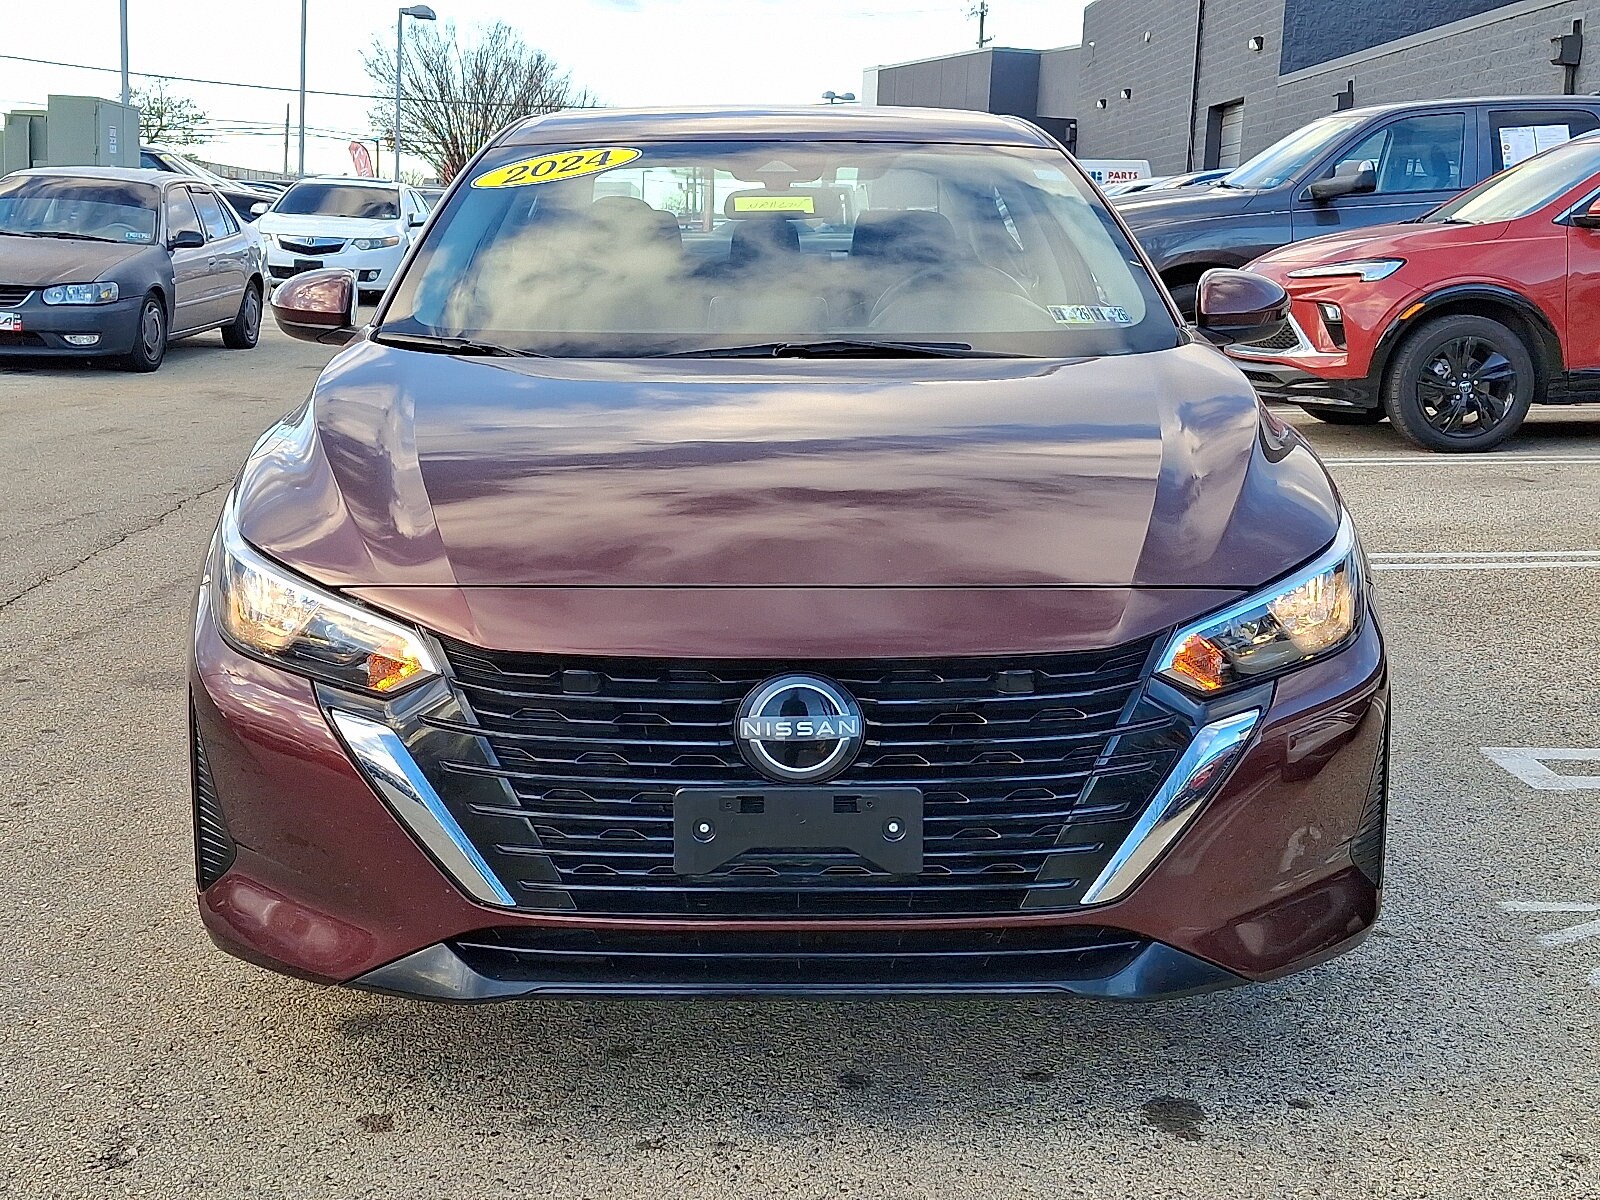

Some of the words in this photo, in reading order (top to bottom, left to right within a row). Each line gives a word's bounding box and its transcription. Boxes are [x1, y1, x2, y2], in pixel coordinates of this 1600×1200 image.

[501, 150, 613, 185] 2024
[1108, 171, 1138, 179] PARTS
[742, 719, 857, 738] NISSAN
